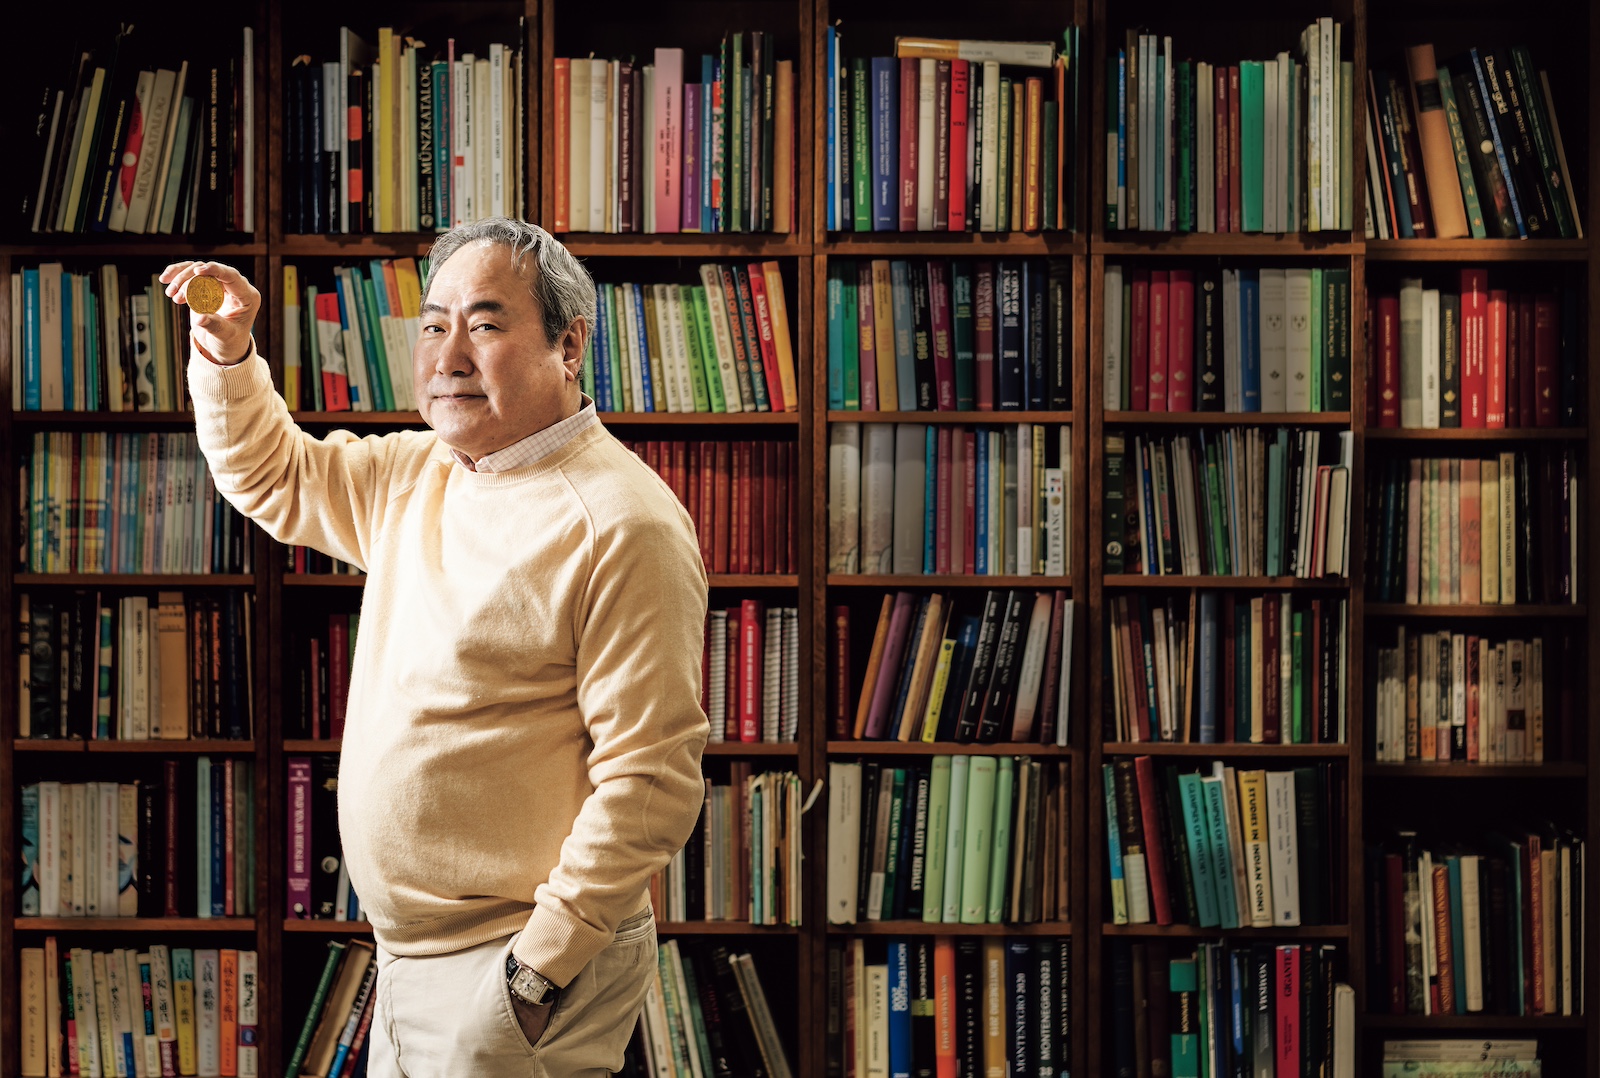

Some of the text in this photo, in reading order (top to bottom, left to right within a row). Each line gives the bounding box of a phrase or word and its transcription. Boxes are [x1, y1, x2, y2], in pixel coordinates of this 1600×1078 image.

[418, 65, 433, 175] MÜNZKATALOG
[842, 135, 850, 184] SOVEREIGN
[723, 272, 735, 300] COINS
[728, 301, 738, 314] OF
[738, 272, 750, 300] COINS
[742, 301, 752, 314] OF
[1002, 270, 1012, 316] ENGLAND
[1011, 270, 1020, 316] COINS OF
[730, 316, 744, 360] ENGLAND
[744, 316, 759, 360] ENGLAND
[756, 294, 772, 341] ENGLAND
[862, 325, 872, 350] 1990
[1034, 322, 1042, 335] OF
[686, 326, 698, 360] ENGLAND
[704, 326, 714, 360] ENGLAND
[936, 328, 950, 359] 1997
[1052, 510, 1060, 564] LE FRANC
[978, 668, 988, 685] AND
[1000, 668, 1011, 685] AND
[1144, 644, 1152, 667] English
[888, 797, 904, 874] SCOTLAND IRELAND
[910, 778, 928, 890] COMMEMORATIVE MEDALS
[1188, 782, 1207, 876] GLIMPSES OF HISTORY
[1210, 786, 1227, 880] GLIMPSES OF HISTORY
[1248, 787, 1264, 912] STUDIES IN INDIAN COINS
[897, 943, 908, 1012] MONTENEGRO
[990, 959, 1000, 1015] MONTENEGRO
[1060, 944, 1068, 1036] COLLECTING GREEK COINS
[1258, 962, 1268, 1012] NOMISMA
[941, 974, 949, 1028] MONTENEGRO
[1039, 960, 1052, 1060] MONTENEGRO 2023
[1016, 994, 1026, 1072] MONTENEGRO
